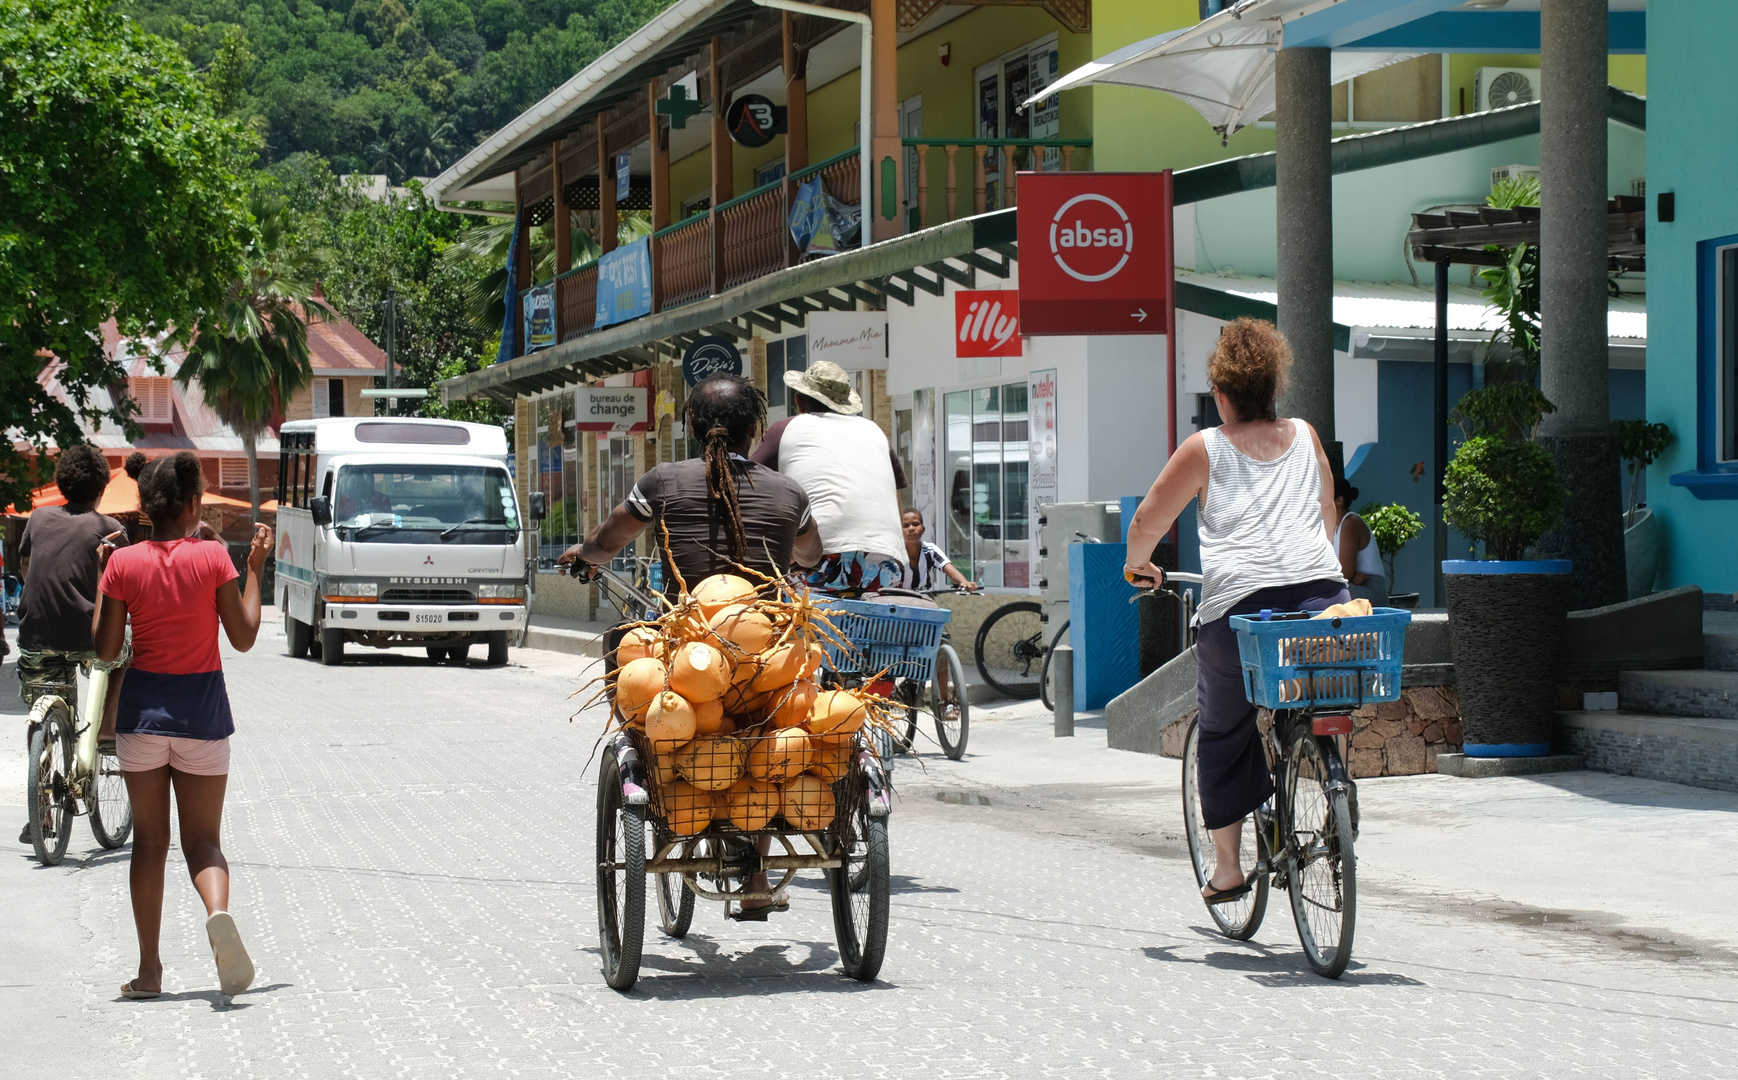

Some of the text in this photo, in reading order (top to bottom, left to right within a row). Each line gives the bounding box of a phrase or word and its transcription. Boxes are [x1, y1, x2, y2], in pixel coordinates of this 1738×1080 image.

[1060, 219, 1123, 247] absa
[959, 299, 1017, 351] illy
[812, 337, 859, 351] Mamma
[860, 327, 883, 341] Mia
[1032, 373, 1054, 399] nutella
[590, 393, 635, 403] bureau de
[590, 404, 635, 417] change
[390, 577, 468, 585] MITSUBISHI
[416, 614, 443, 624] S15020
